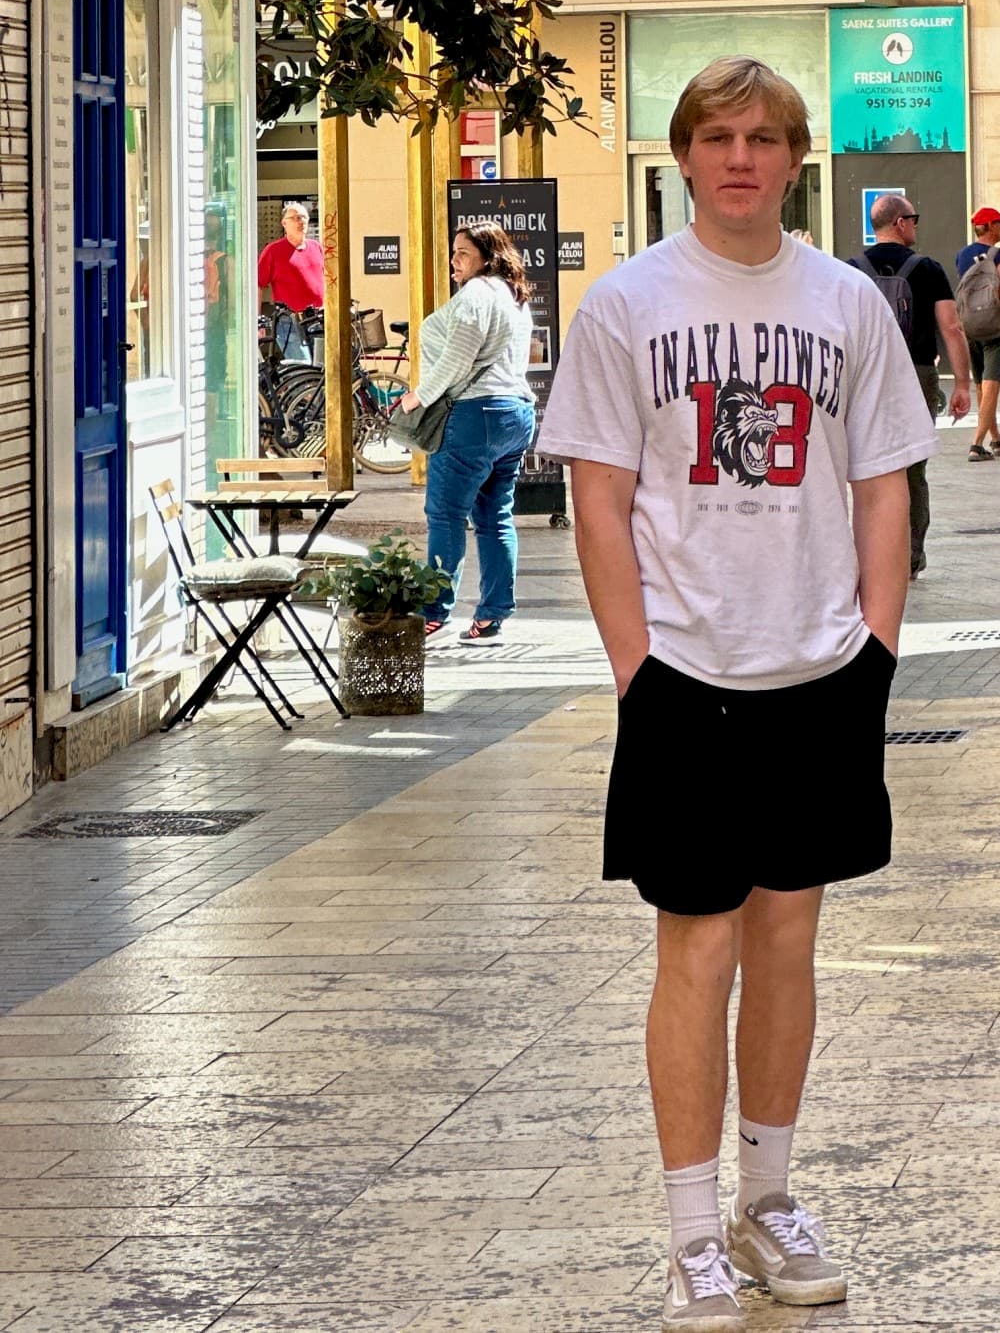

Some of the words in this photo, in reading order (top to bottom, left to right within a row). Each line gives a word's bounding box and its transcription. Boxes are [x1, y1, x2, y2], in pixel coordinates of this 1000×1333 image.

[841, 19, 875, 29] SAENZ
[877, 18, 909, 28] SUITES
[911, 17, 954, 27] GALLERY
[854, 87, 904, 95] VACATIONAL
[906, 86, 943, 94] RENTALS
[866, 98, 885, 108] 951
[888, 98, 906, 108] 915
[910, 98, 931, 108] 394
[378, 244, 398, 252] ALAIN
[561, 241, 583, 250] ALAIN
[367, 252, 398, 260] AFFLELOU
[650, 322, 742, 410] INAKA
[754, 322, 844, 418] POWER
